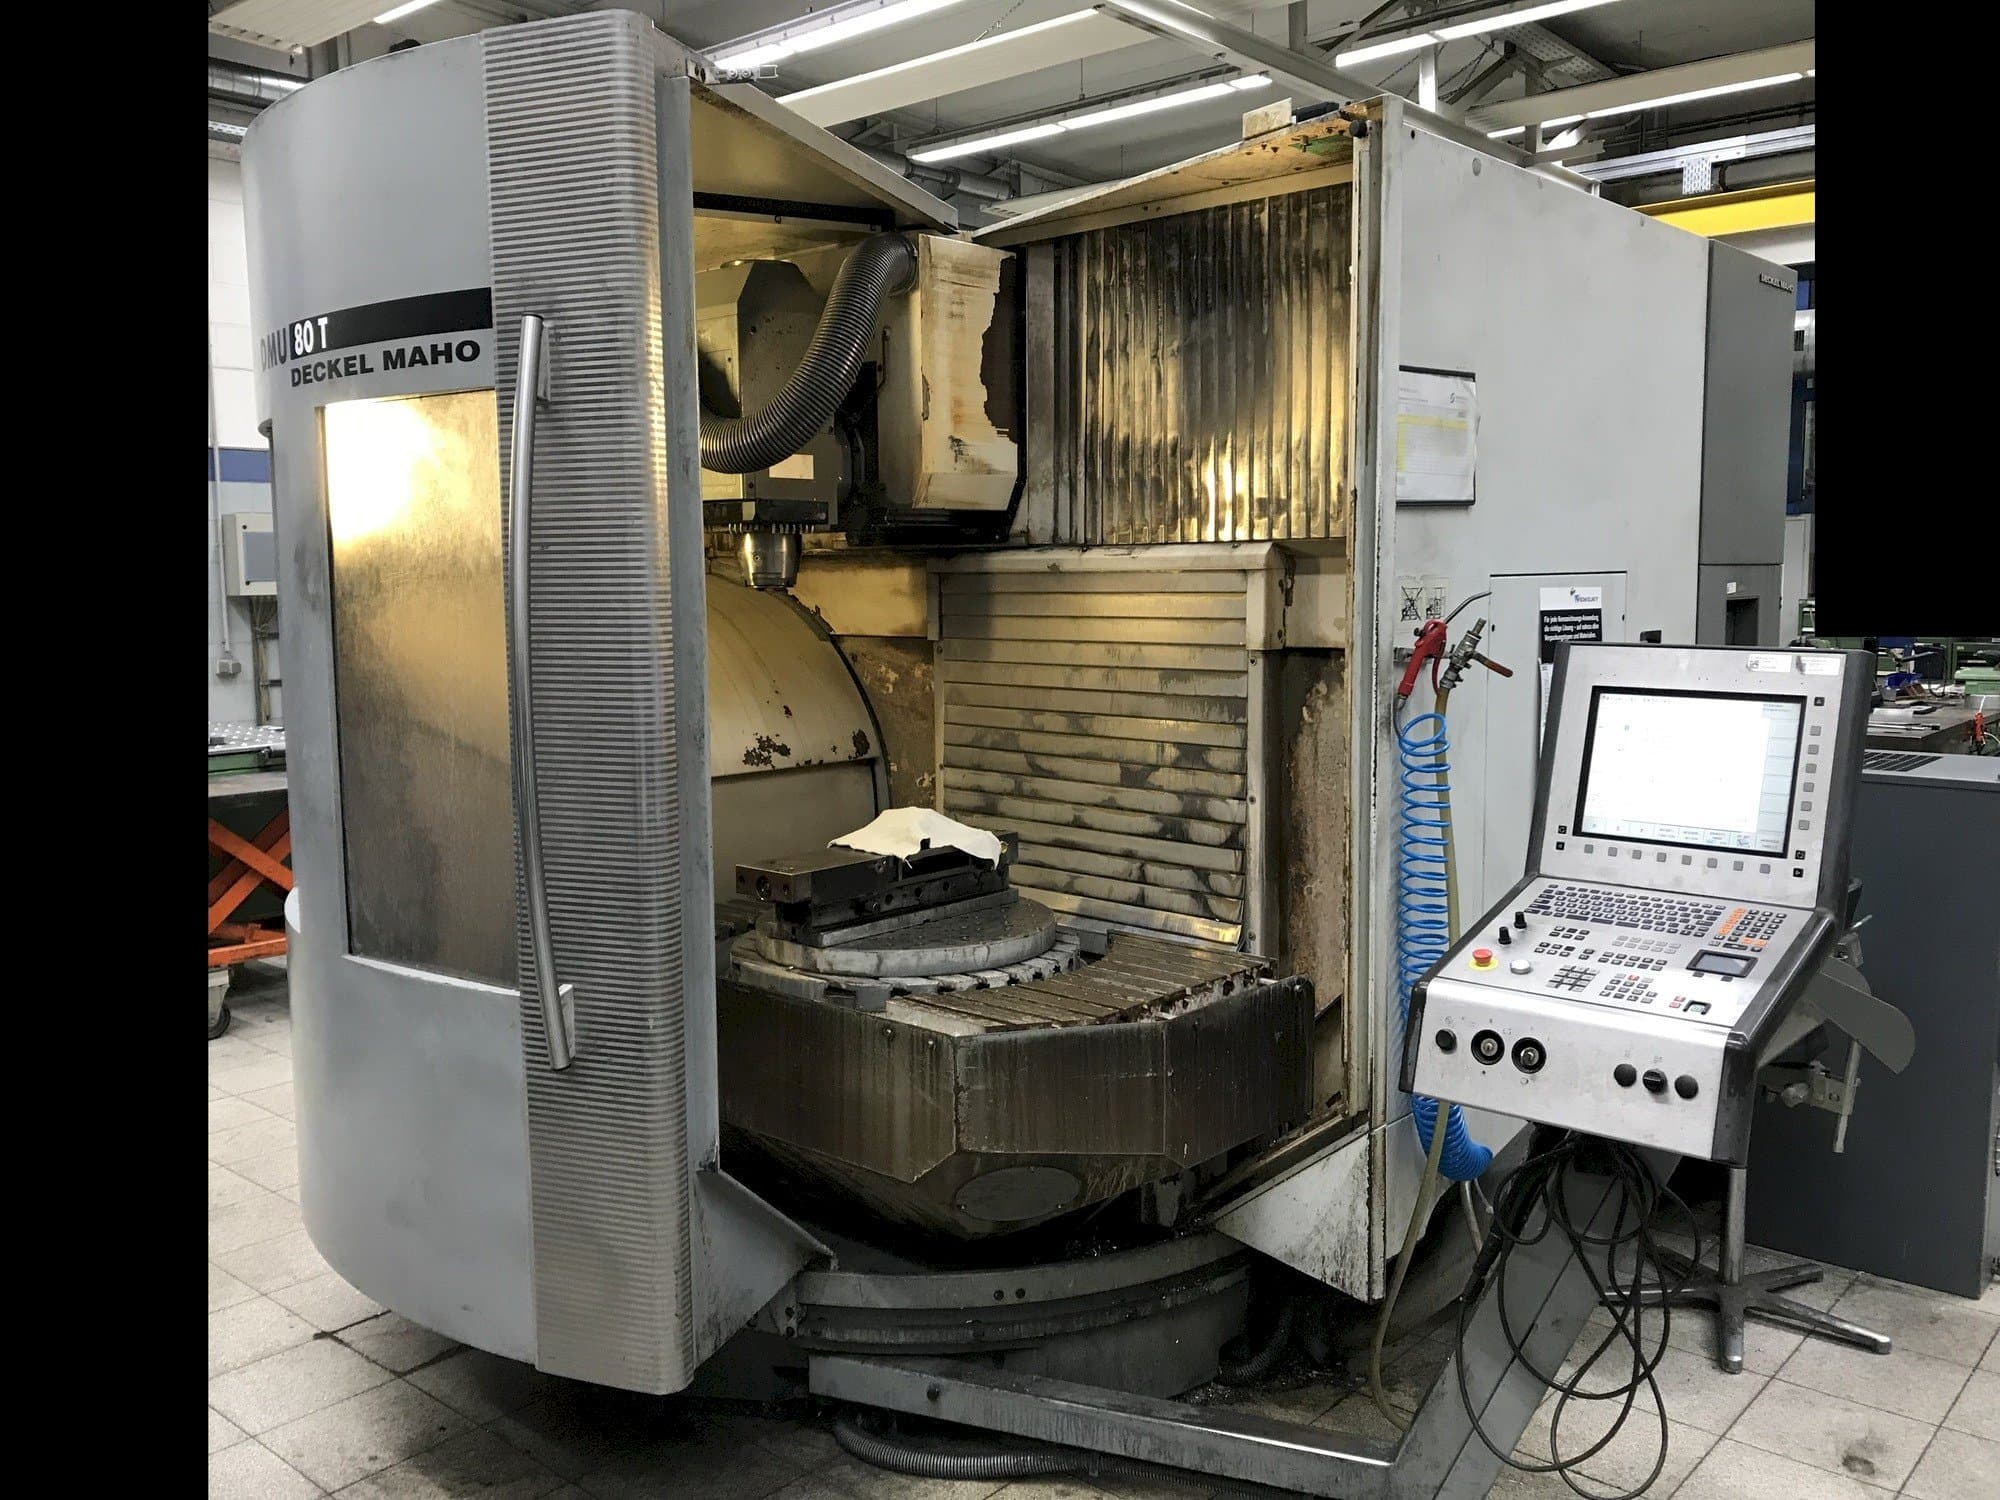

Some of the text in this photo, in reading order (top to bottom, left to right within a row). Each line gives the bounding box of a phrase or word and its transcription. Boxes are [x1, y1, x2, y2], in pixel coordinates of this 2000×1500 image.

[260, 316, 329, 373] DMU 80 T
[291, 339, 481, 388] DECKEL MAHO
